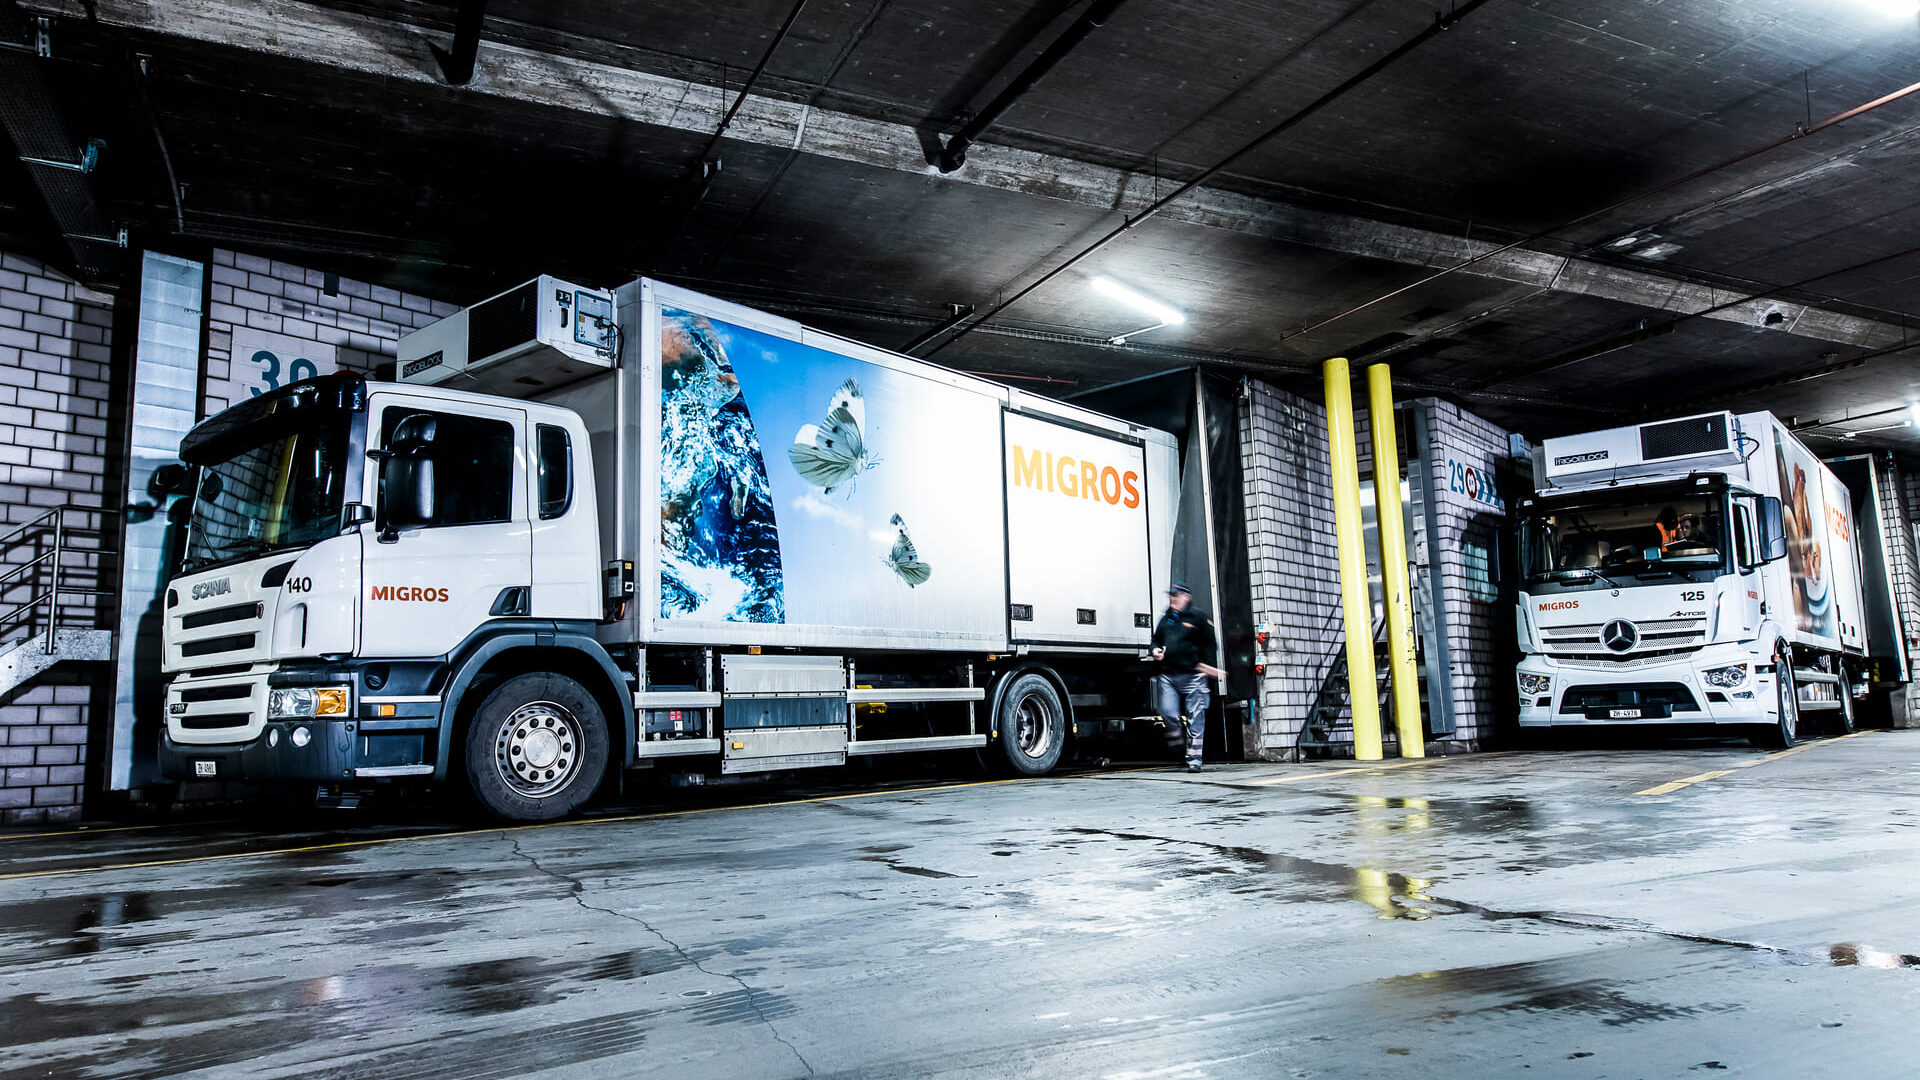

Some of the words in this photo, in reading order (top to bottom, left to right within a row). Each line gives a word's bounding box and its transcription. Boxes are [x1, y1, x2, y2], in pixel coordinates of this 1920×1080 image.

[1012, 444, 1140, 509] MIGROS
[1448, 458, 1465, 495] 29
[191, 577, 231, 600] SCANIA
[286, 576, 312, 594] 140
[371, 585, 449, 602] MIGROS
[1680, 590, 1705, 602] 125
[1538, 600, 1580, 612] MIGROS
